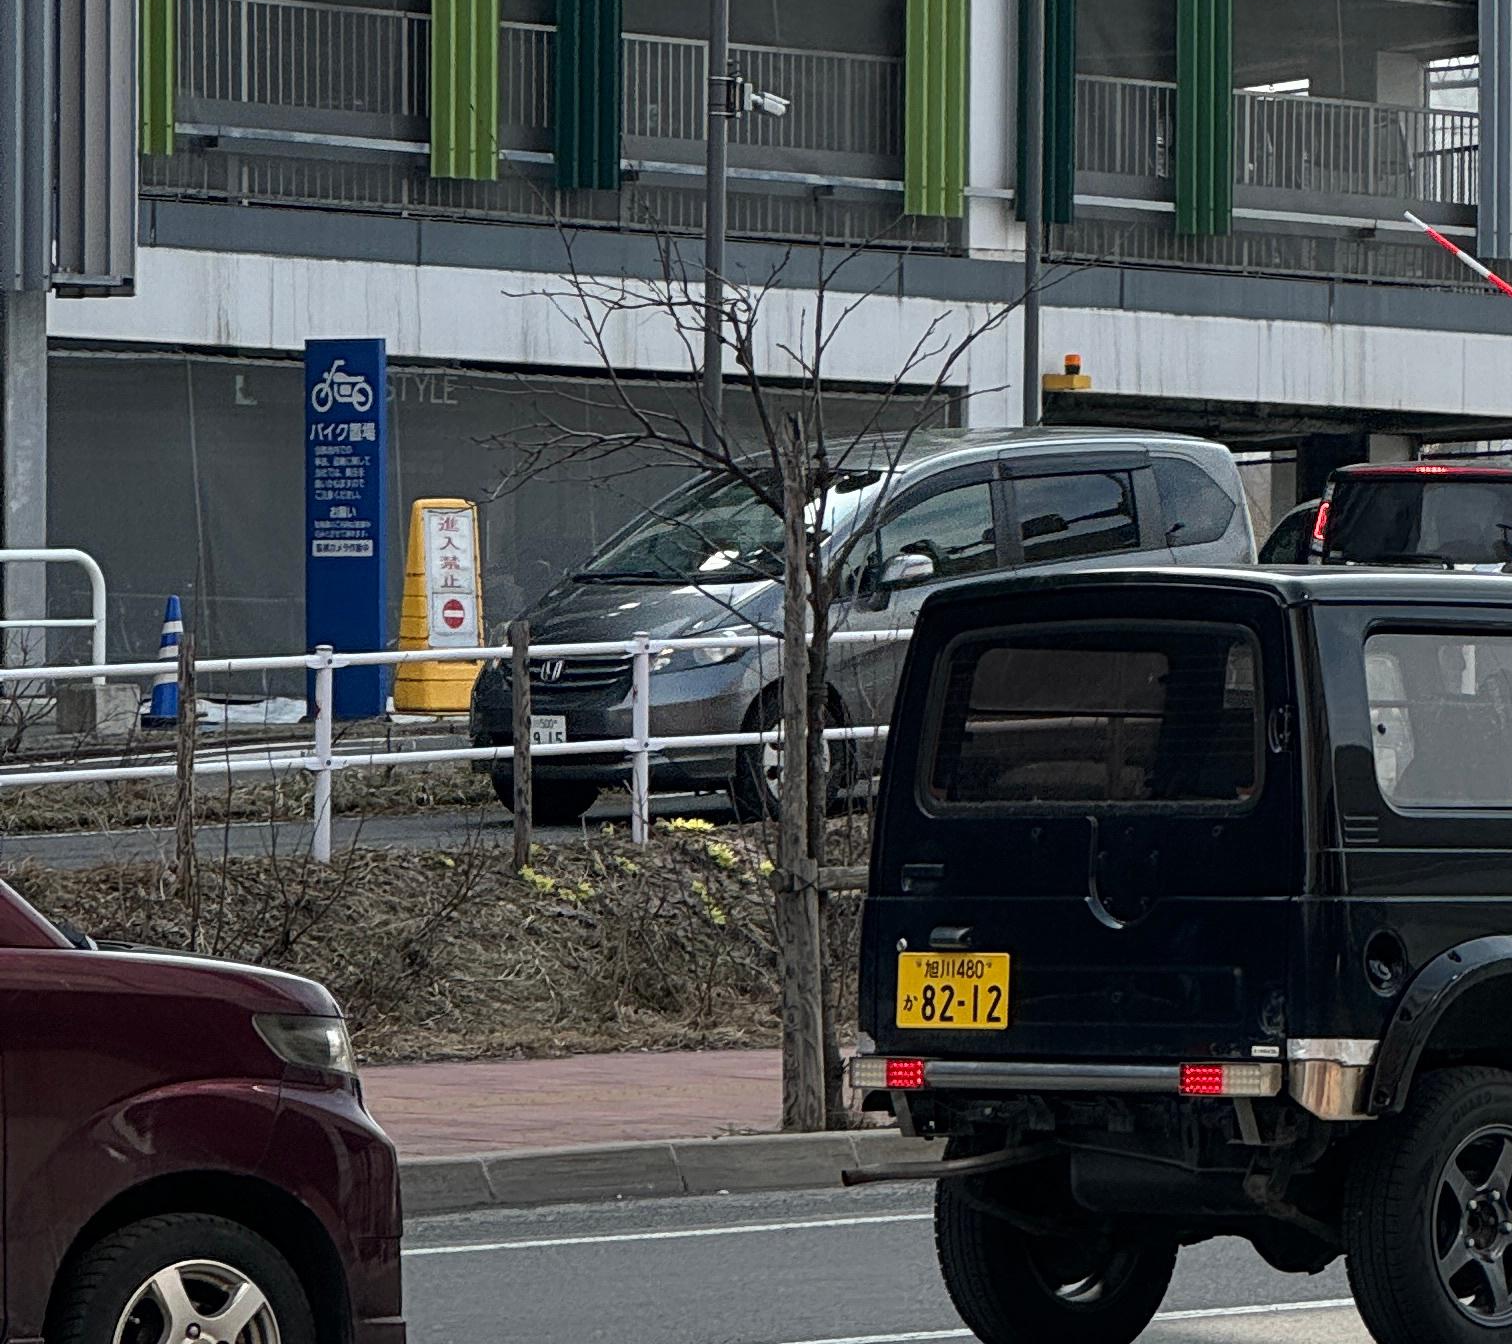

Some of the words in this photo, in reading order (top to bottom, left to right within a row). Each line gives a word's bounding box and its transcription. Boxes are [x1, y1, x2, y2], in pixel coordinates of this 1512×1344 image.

[438, 517, 462, 588] 進入禁止
[924, 959, 984, 979] 旭川480
[903, 994, 918, 1012] か
[921, 984, 1002, 1023] 82-12
